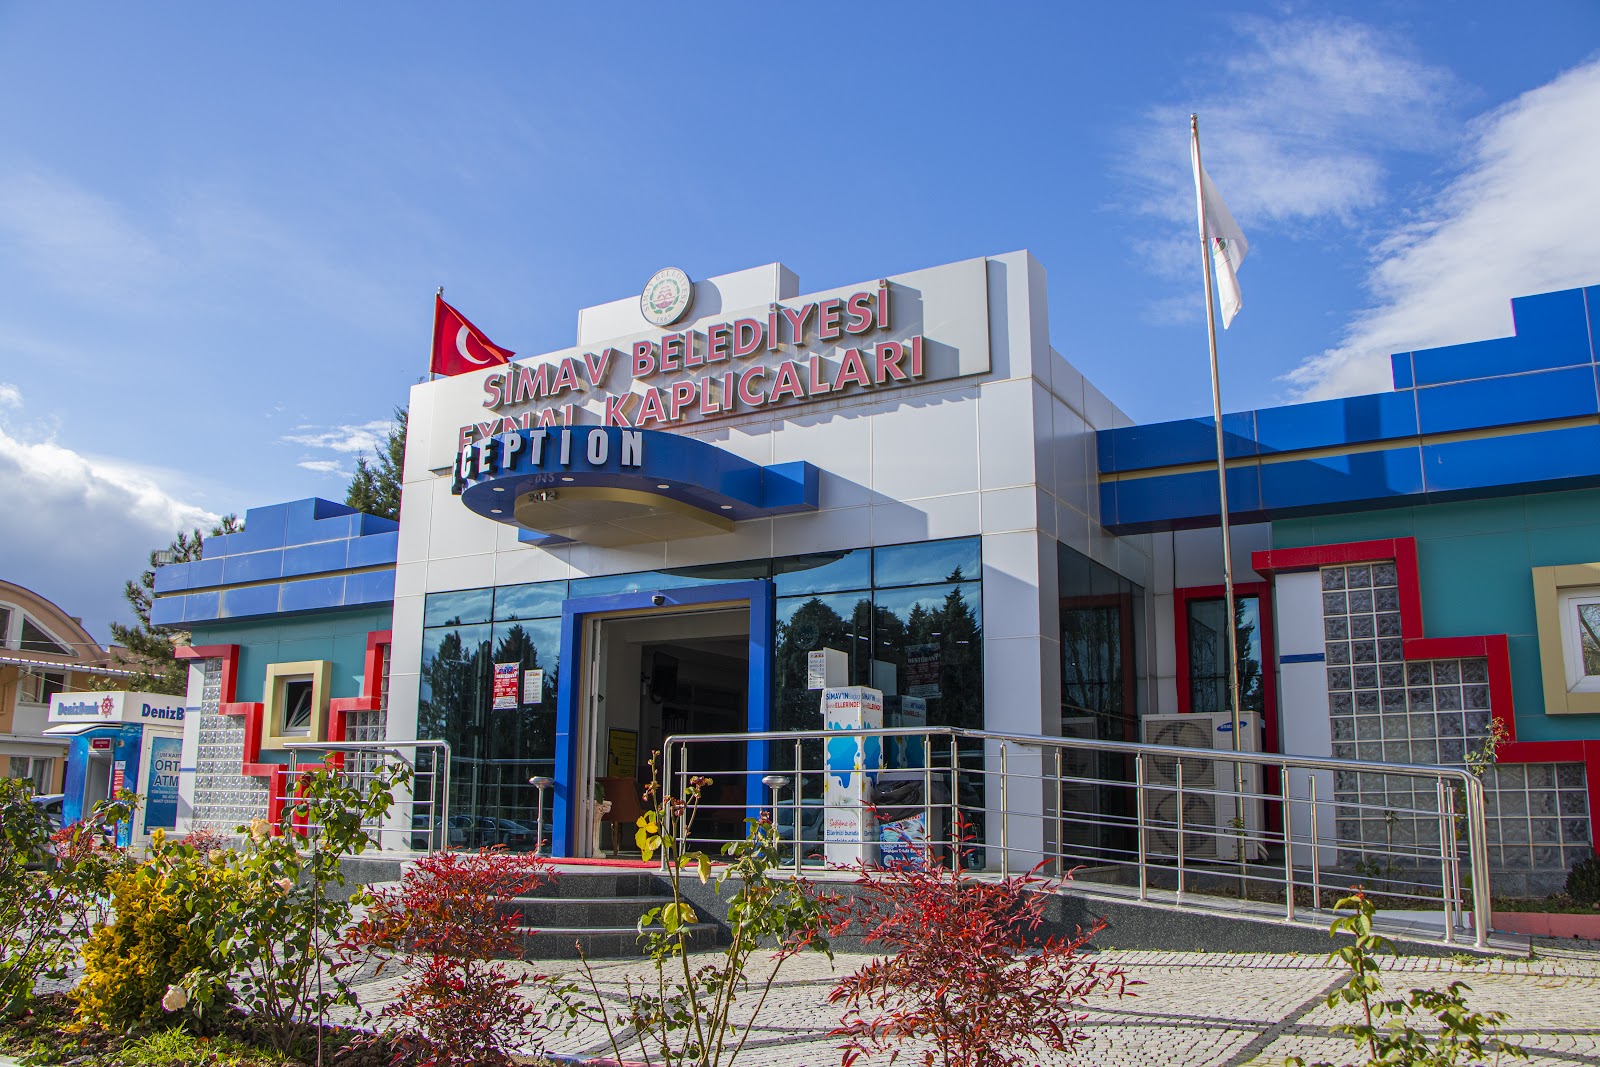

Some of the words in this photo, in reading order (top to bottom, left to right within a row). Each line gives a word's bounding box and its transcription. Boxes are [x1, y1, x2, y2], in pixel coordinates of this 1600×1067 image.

[482, 346, 613, 410] SİMAV
[631, 278, 888, 378] BELEDİYESİ
[604, 334, 924, 428] KAPLICALARI
[57, 701, 99, 716] DenizBank
[154, 760, 181, 772] ORT
[153, 775, 179, 787] ATM
